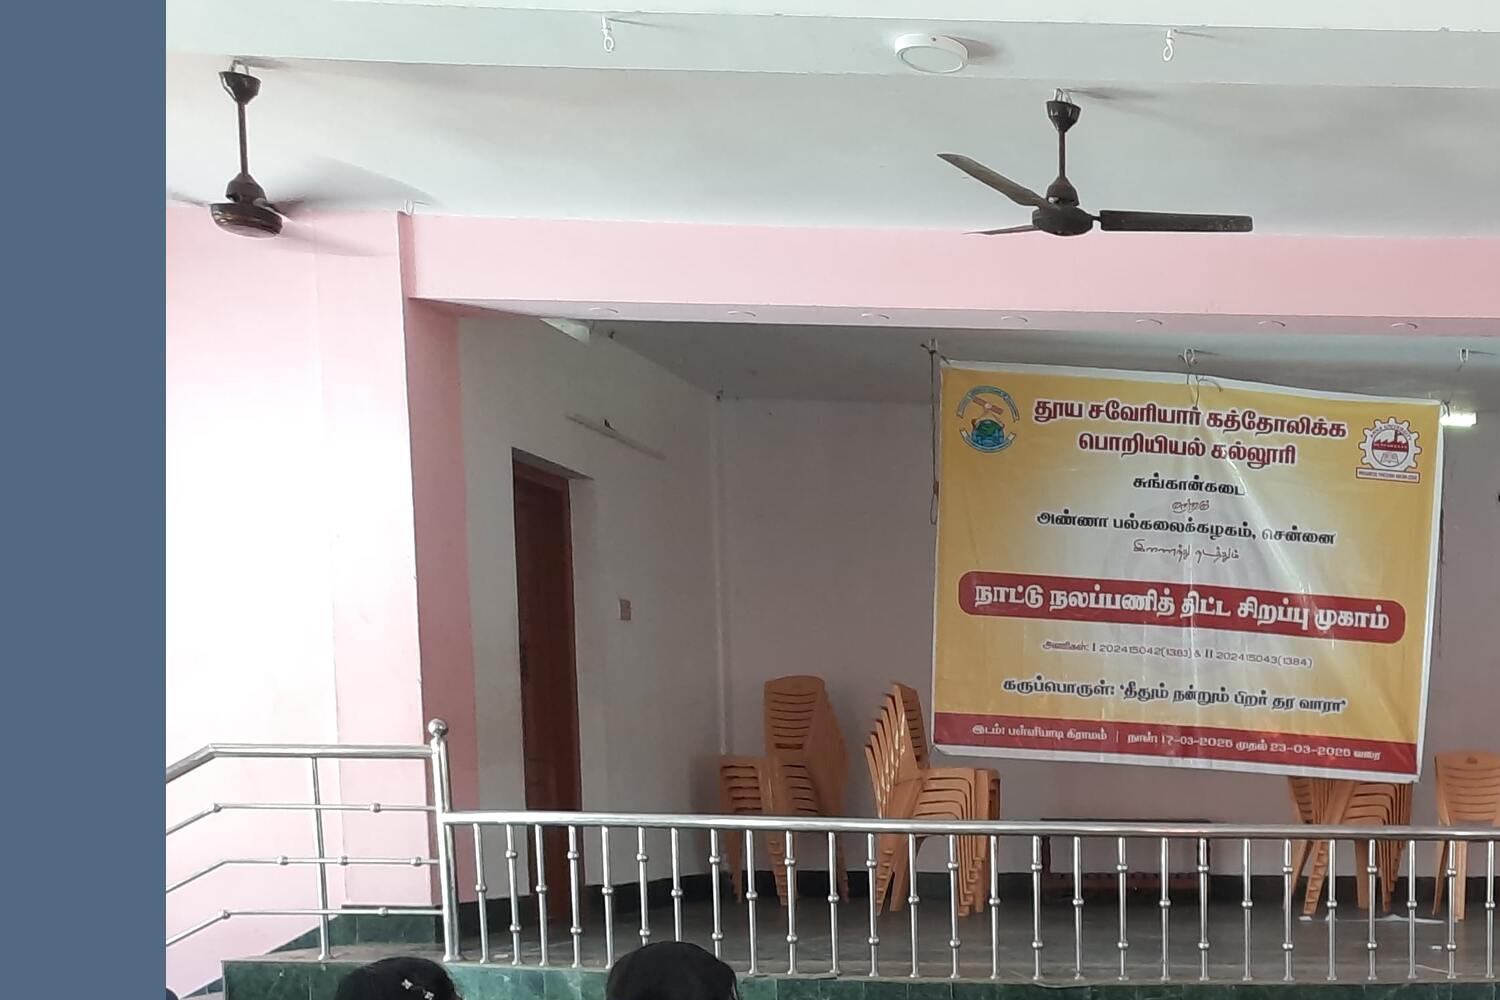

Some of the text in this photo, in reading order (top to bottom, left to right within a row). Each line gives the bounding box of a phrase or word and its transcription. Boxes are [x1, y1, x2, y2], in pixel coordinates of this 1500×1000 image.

[1034, 400, 1083, 423] தூய
[1088, 399, 1202, 426] சவேரியார்
[1207, 409, 1347, 438] கத்தோலிக்க
[1078, 432, 1297, 470] பொறியியல் கல்லூரி
[1133, 471, 1245, 496] சுங்கான்கடை
[1037, 508, 1336, 545] அண்ணா பல்கலைக்கழகம், சென்னை
[975, 583, 1390, 632] நாட்டு நலப்பணித் திட்ட சிறப்பு முகாம்
[1193, 650, 1202, 658] &
[1003, 674, 1116, 698] கருப்பொருள்:
[1173, 684, 1230, 706] நன்றும்
[1234, 689, 1269, 707] பிறர்
[1272, 697, 1295, 710] தர
